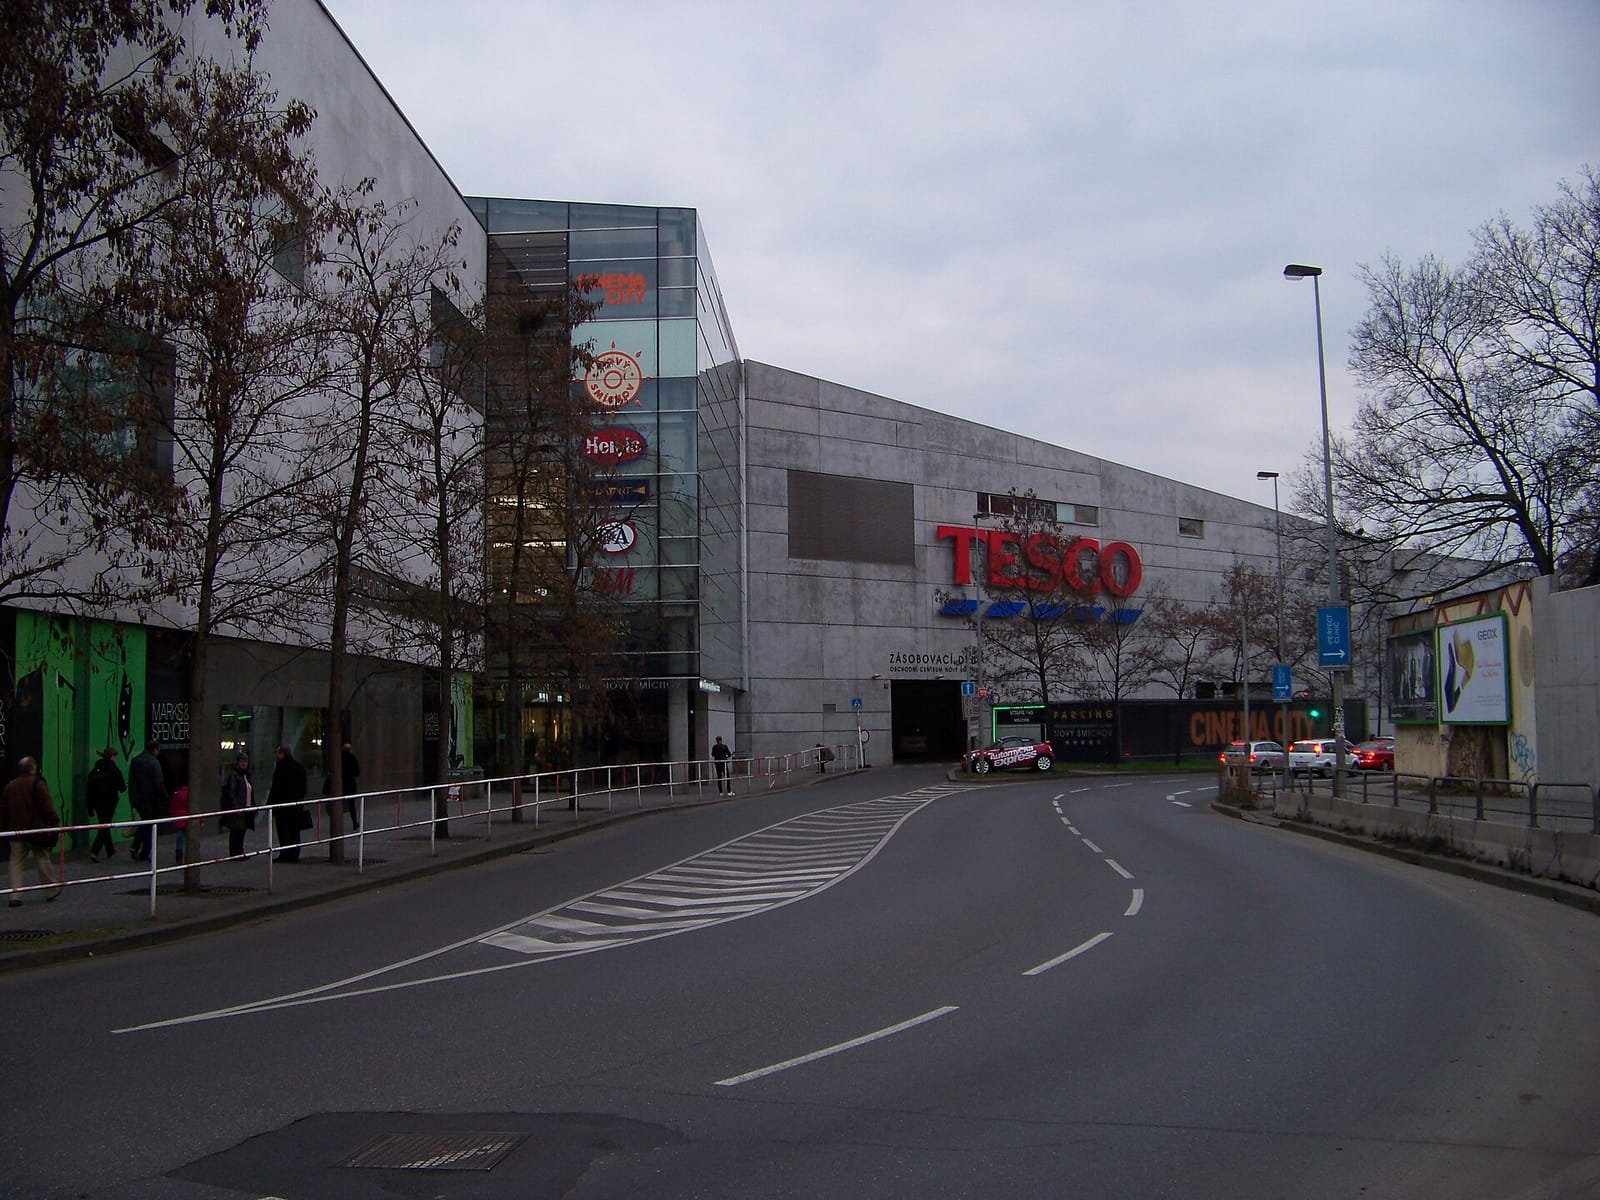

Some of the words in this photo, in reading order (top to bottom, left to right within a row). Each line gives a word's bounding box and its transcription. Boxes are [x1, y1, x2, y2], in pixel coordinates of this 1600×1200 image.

[606, 288, 645, 305] CITY
[936, 524, 1143, 597] TESCO
[1477, 629, 1498, 641] GEOX
[889, 652, 954, 664] ZÁSOBOVACÍ
[1053, 709, 1113, 720] PARKING
[151, 722, 192, 742] SPENCER
[1189, 710, 1271, 746] CINEMA
[1273, 710, 1314, 741] CITY
[994, 750, 1038, 767] Express
